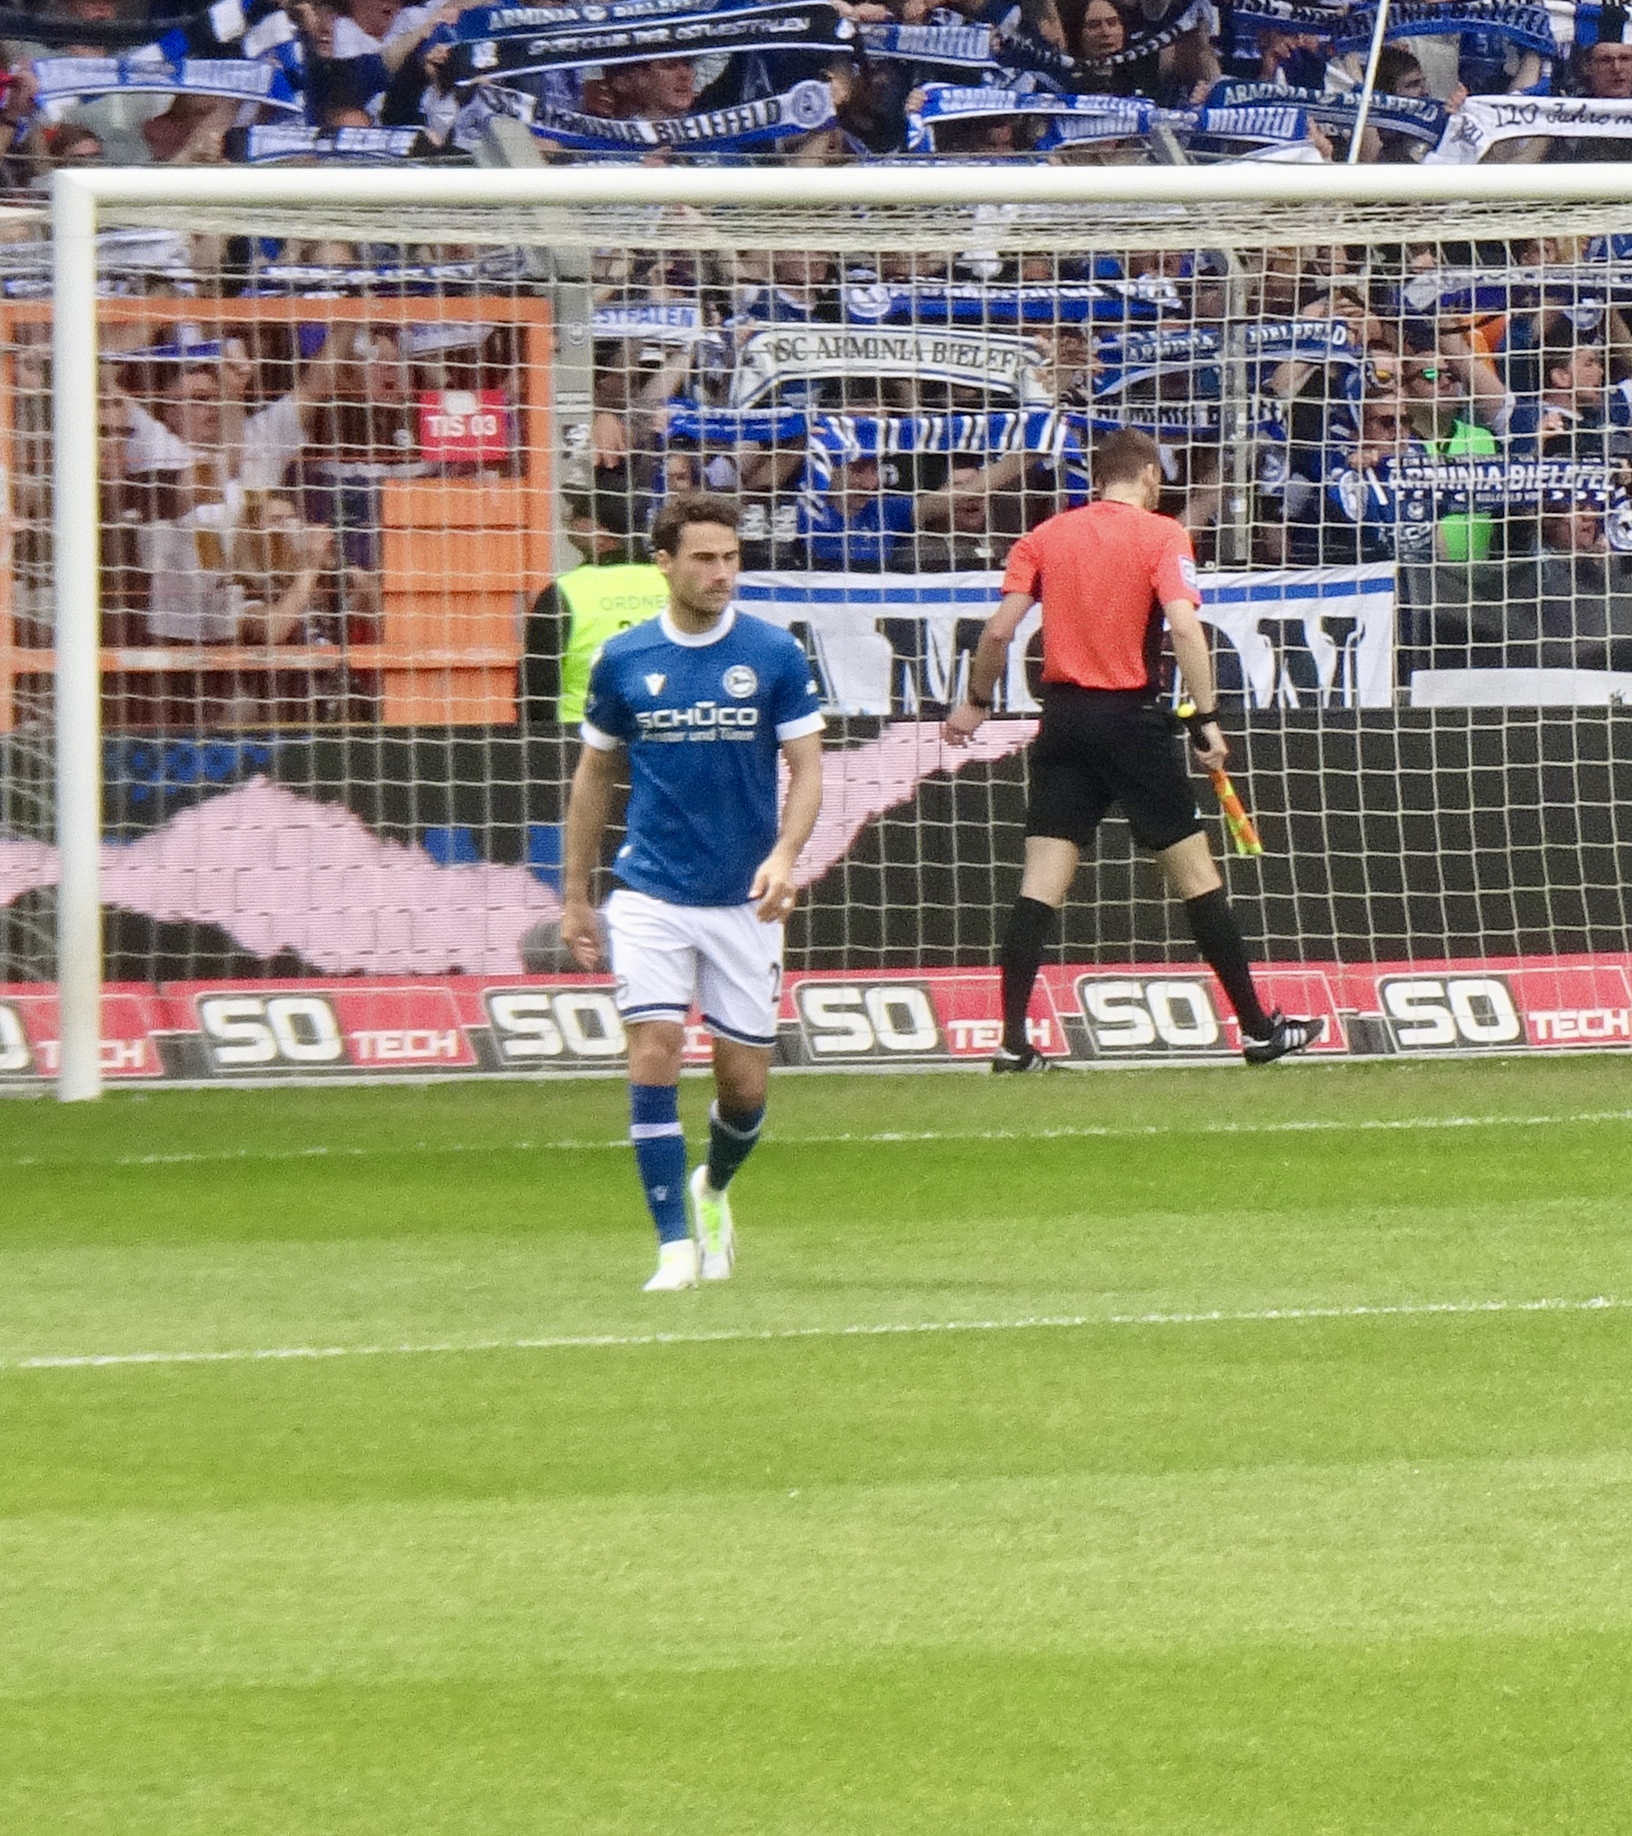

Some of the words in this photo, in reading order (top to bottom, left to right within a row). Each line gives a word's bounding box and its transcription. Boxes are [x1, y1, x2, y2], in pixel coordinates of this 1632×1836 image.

[816, 337, 923, 366] ARMINIA
[425, 416, 466, 436] TIS
[470, 414, 498, 437] 03
[600, 595, 669, 613] ORDNE
[636, 701, 759, 730] SCHÜCO
[201, 996, 345, 1064] SO
[350, 1029, 458, 1061] TECH
[491, 991, 629, 1057] SO
[800, 984, 937, 1055] SO
[1084, 976, 1219, 1048] SO
[1381, 978, 1523, 1049] SO
[1530, 1009, 1631, 1044] TECH
